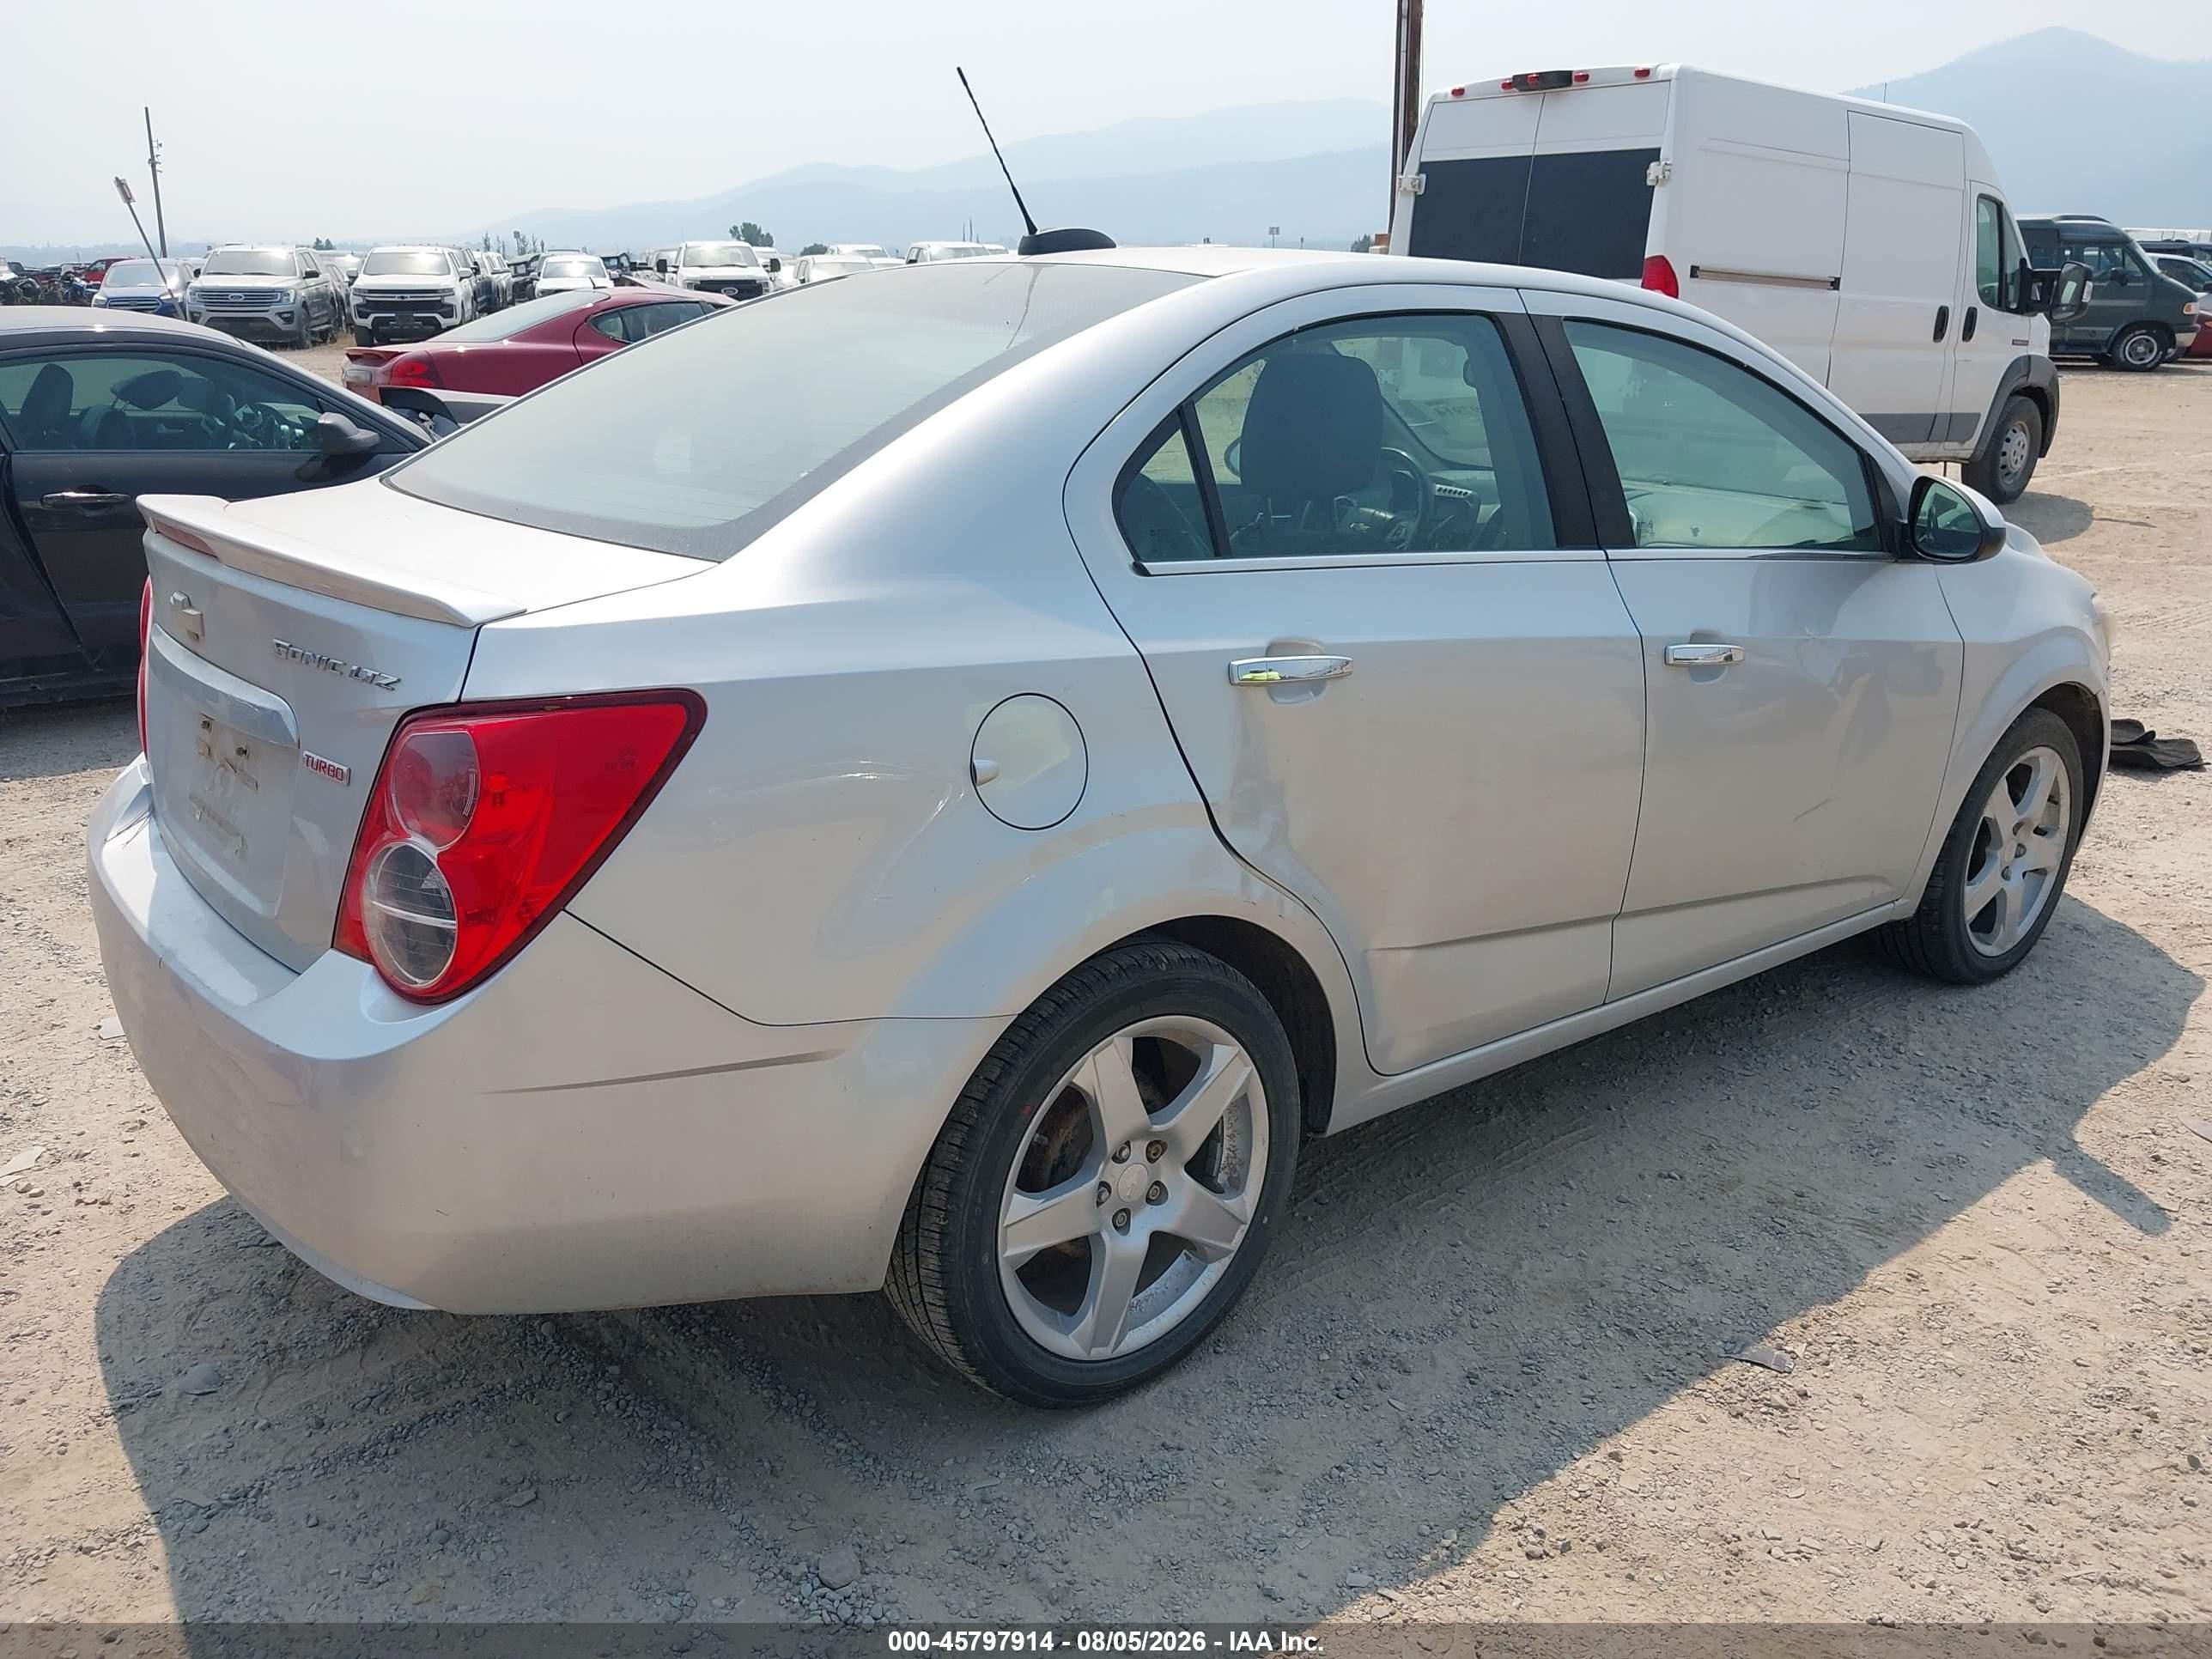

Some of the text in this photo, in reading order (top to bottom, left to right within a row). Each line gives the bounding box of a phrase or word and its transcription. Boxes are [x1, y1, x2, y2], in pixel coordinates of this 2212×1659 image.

[272, 638, 402, 692] SONIC LTZ
[304, 753, 345, 781] TURBO
